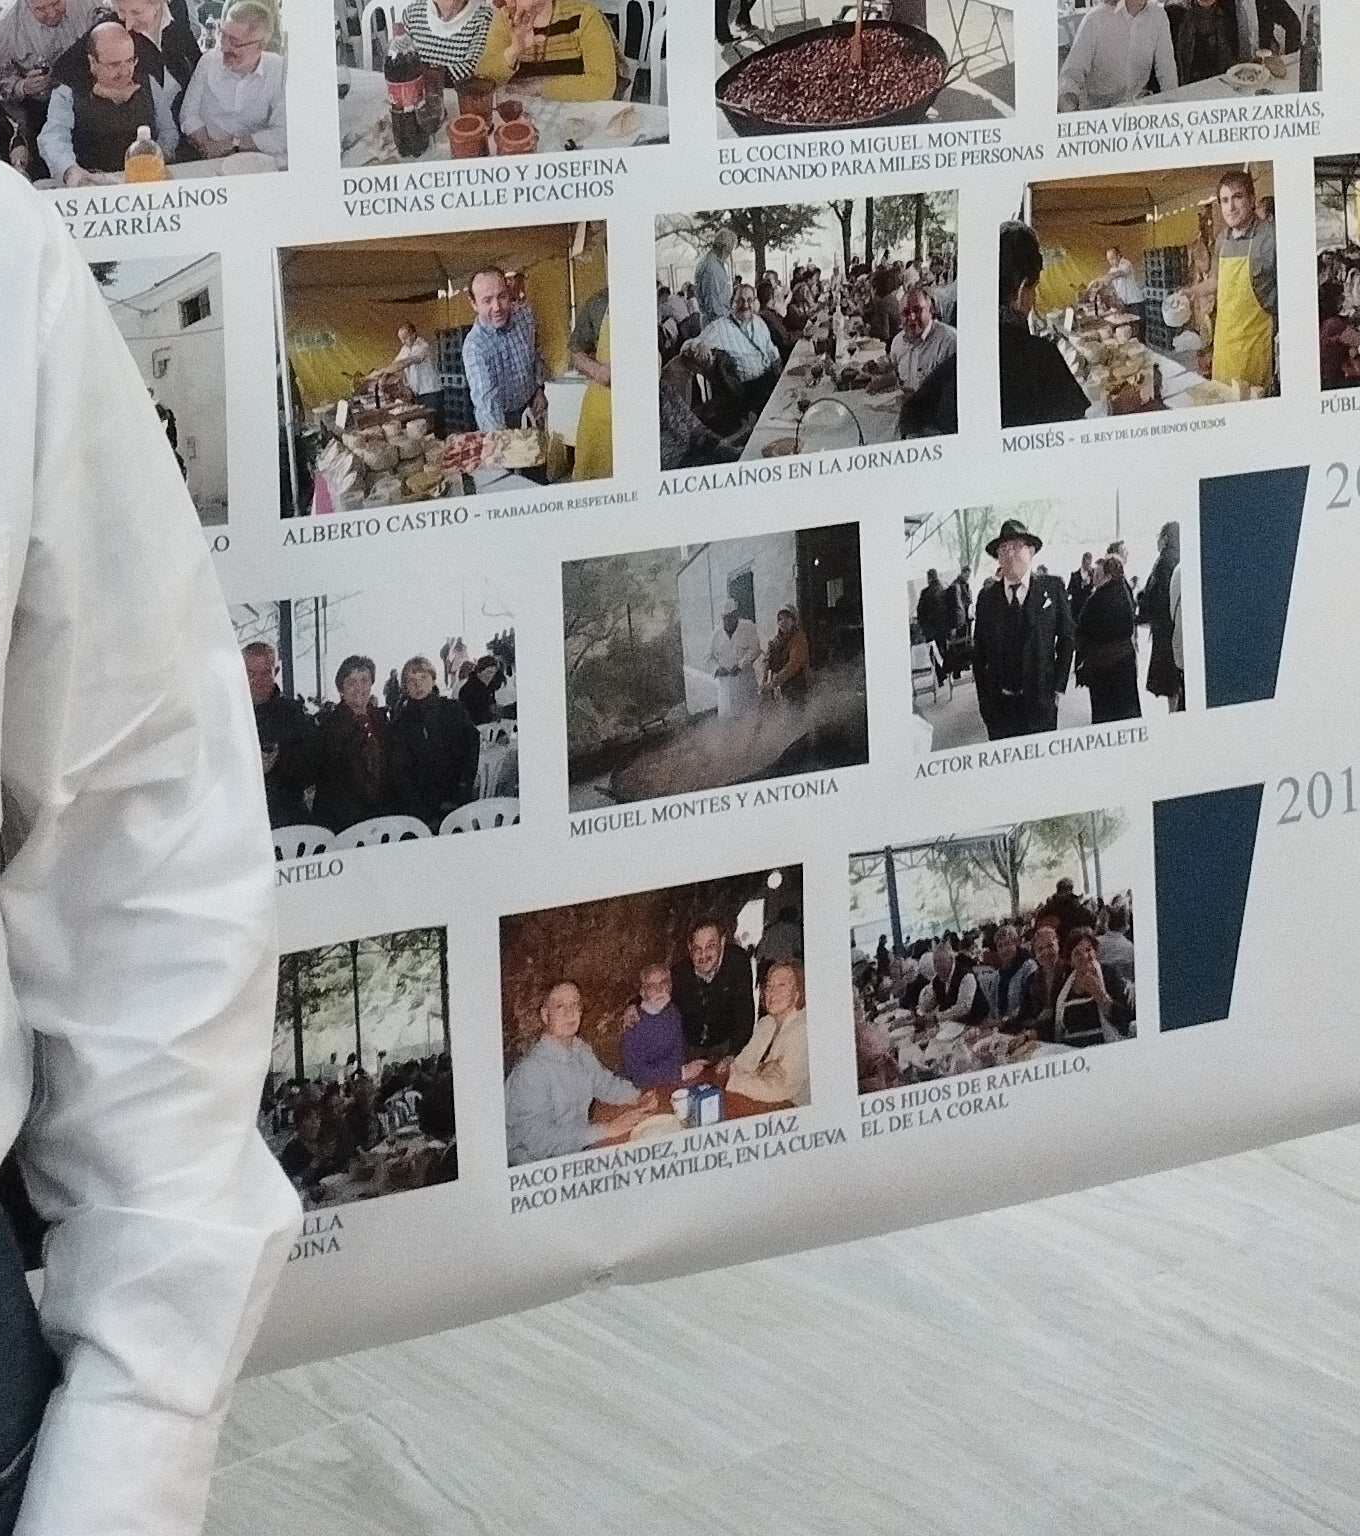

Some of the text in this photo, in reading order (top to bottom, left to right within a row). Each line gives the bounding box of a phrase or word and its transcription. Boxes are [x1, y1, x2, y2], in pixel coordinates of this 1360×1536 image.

[719, 128, 1001, 164] EL COCINERO MIGUEL MONTES
[719, 144, 1044, 185] COCINANDO PARA MILES DE PERSONAS
[343, 157, 628, 195] DOMI ACEITUNO Y JOSEFINA
[86, 187, 228, 215] ALCALAÍNOS
[344, 180, 614, 217] VECINAS CALLE PICACHOS
[83, 214, 181, 239] ZARRÍAS
[282, 491, 638, 547] ALBERTO CASTRO TRABAJADOR RESPETABLE
[914, 726, 1149, 779] ACTOR RAFAEL CHAPALETE
[570, 777, 839, 838] MIGUEL MONTES Y ANTONIA
[860, 1056, 1090, 1117] LOS HIJOS DE RAFALILLO,
[861, 1093, 1009, 1138] EL DE LA CORAL
